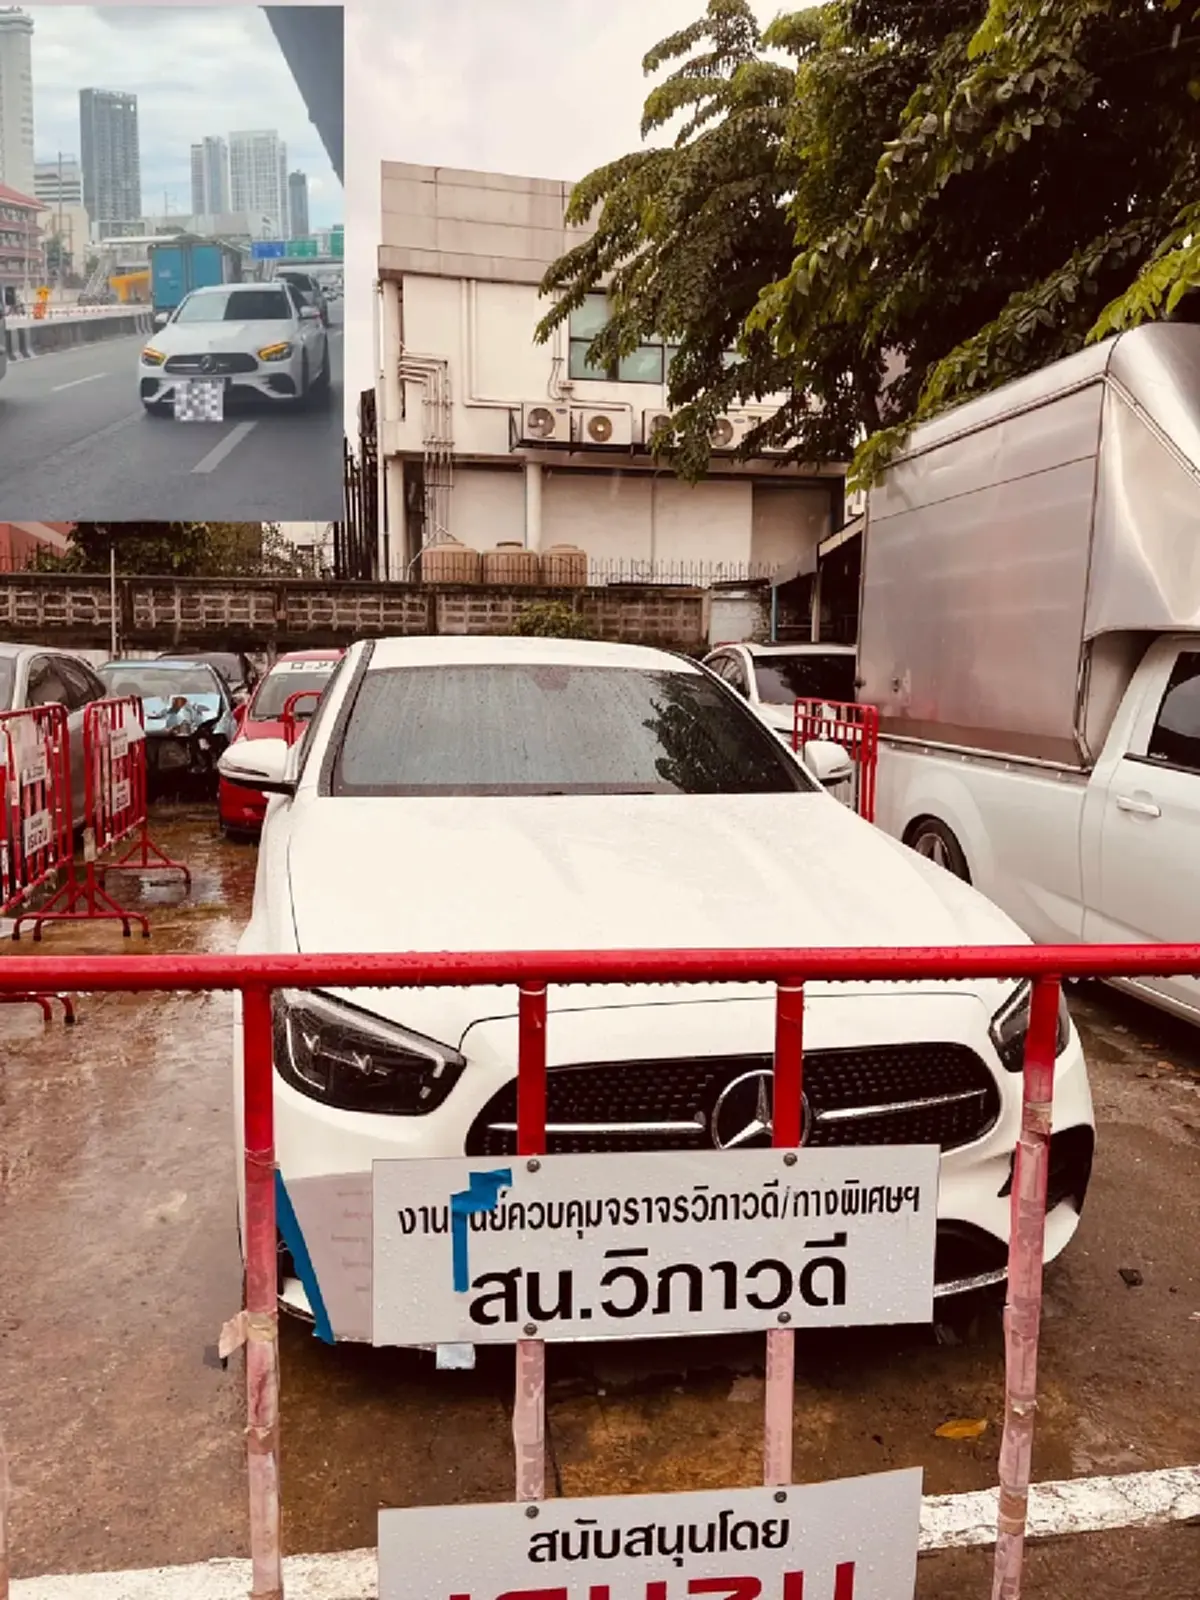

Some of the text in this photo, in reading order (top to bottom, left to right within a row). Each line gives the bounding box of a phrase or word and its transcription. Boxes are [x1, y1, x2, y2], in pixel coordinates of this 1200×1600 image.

[398, 1178, 920, 1240] งานนย์ควบคุมจราจรวิภาวดี/ทางพิเศษฯ
[469, 1232, 847, 1326] สน.วิภาวดี
[527, 1510, 790, 1568] สนับสนุนโดย
